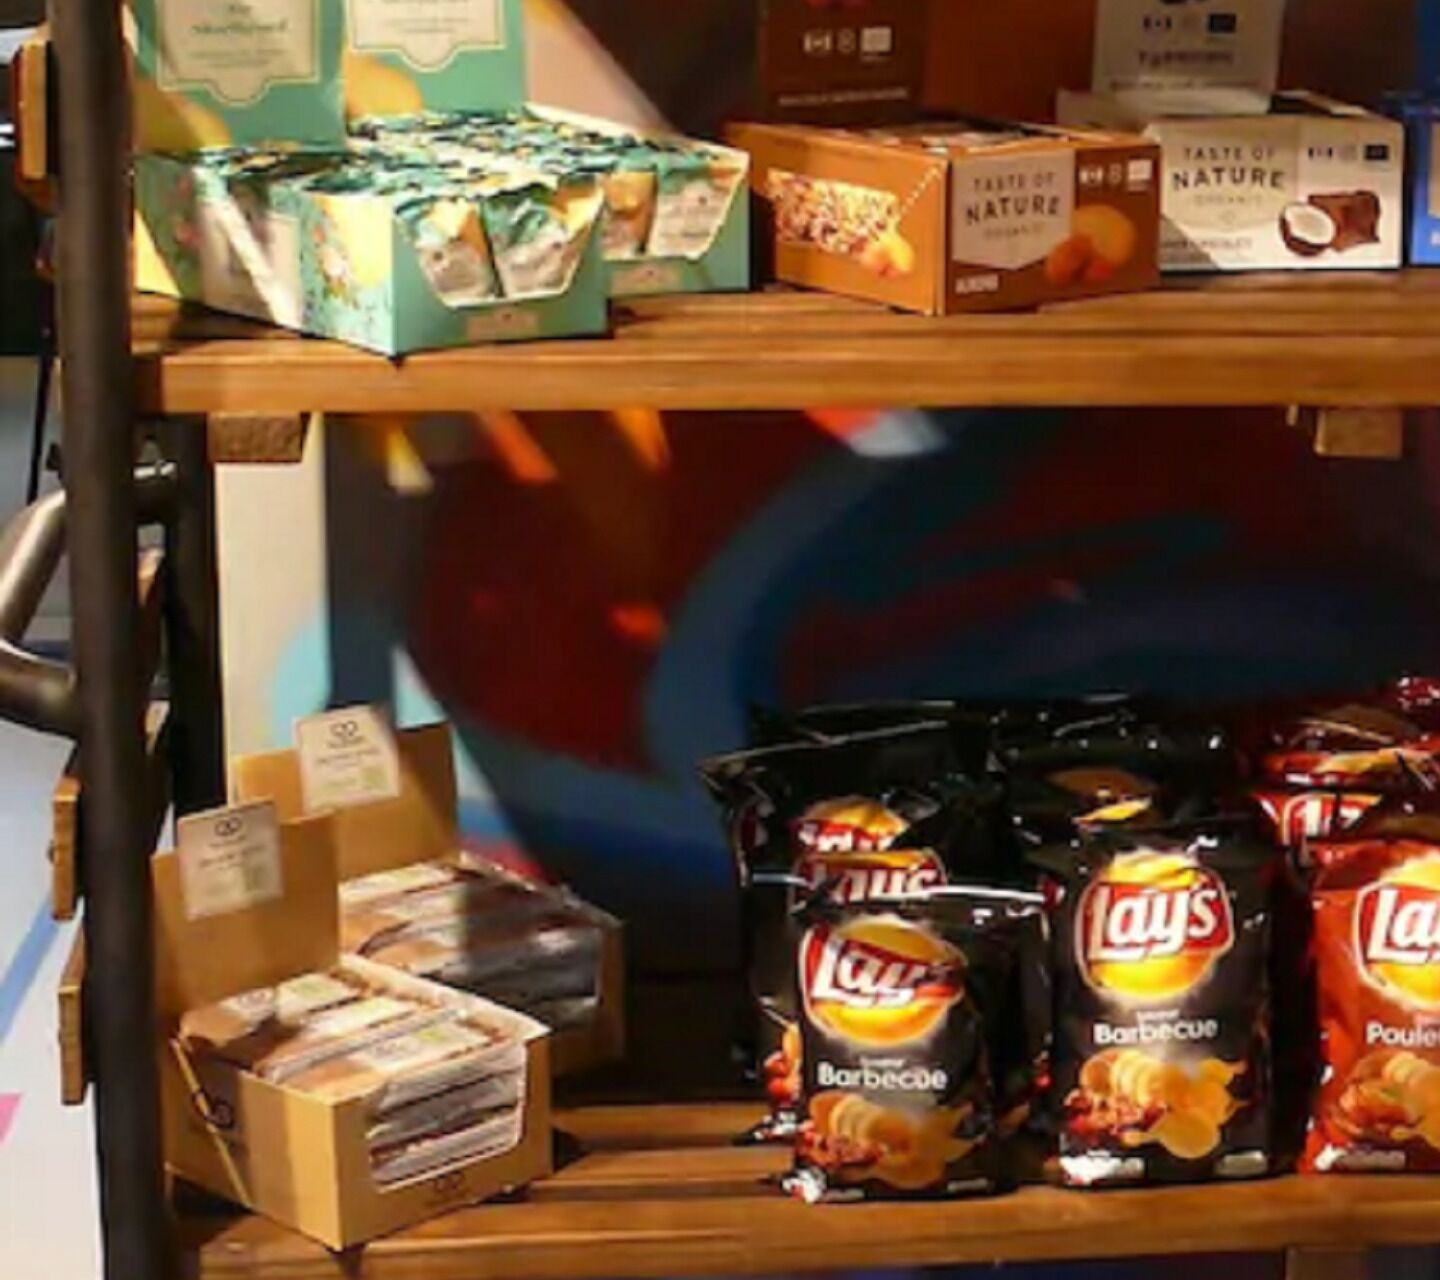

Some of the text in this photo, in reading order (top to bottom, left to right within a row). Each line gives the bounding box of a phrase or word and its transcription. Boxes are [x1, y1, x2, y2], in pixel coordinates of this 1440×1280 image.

[1183, 145, 1243, 162] TASTE
[974, 174, 1024, 193] TASTE
[1173, 167, 1285, 190] NATURE
[966, 194, 1061, 225] NATURE
[1093, 1019, 1219, 1045] Barbecue
[817, 1062, 949, 1091] Barbecue
